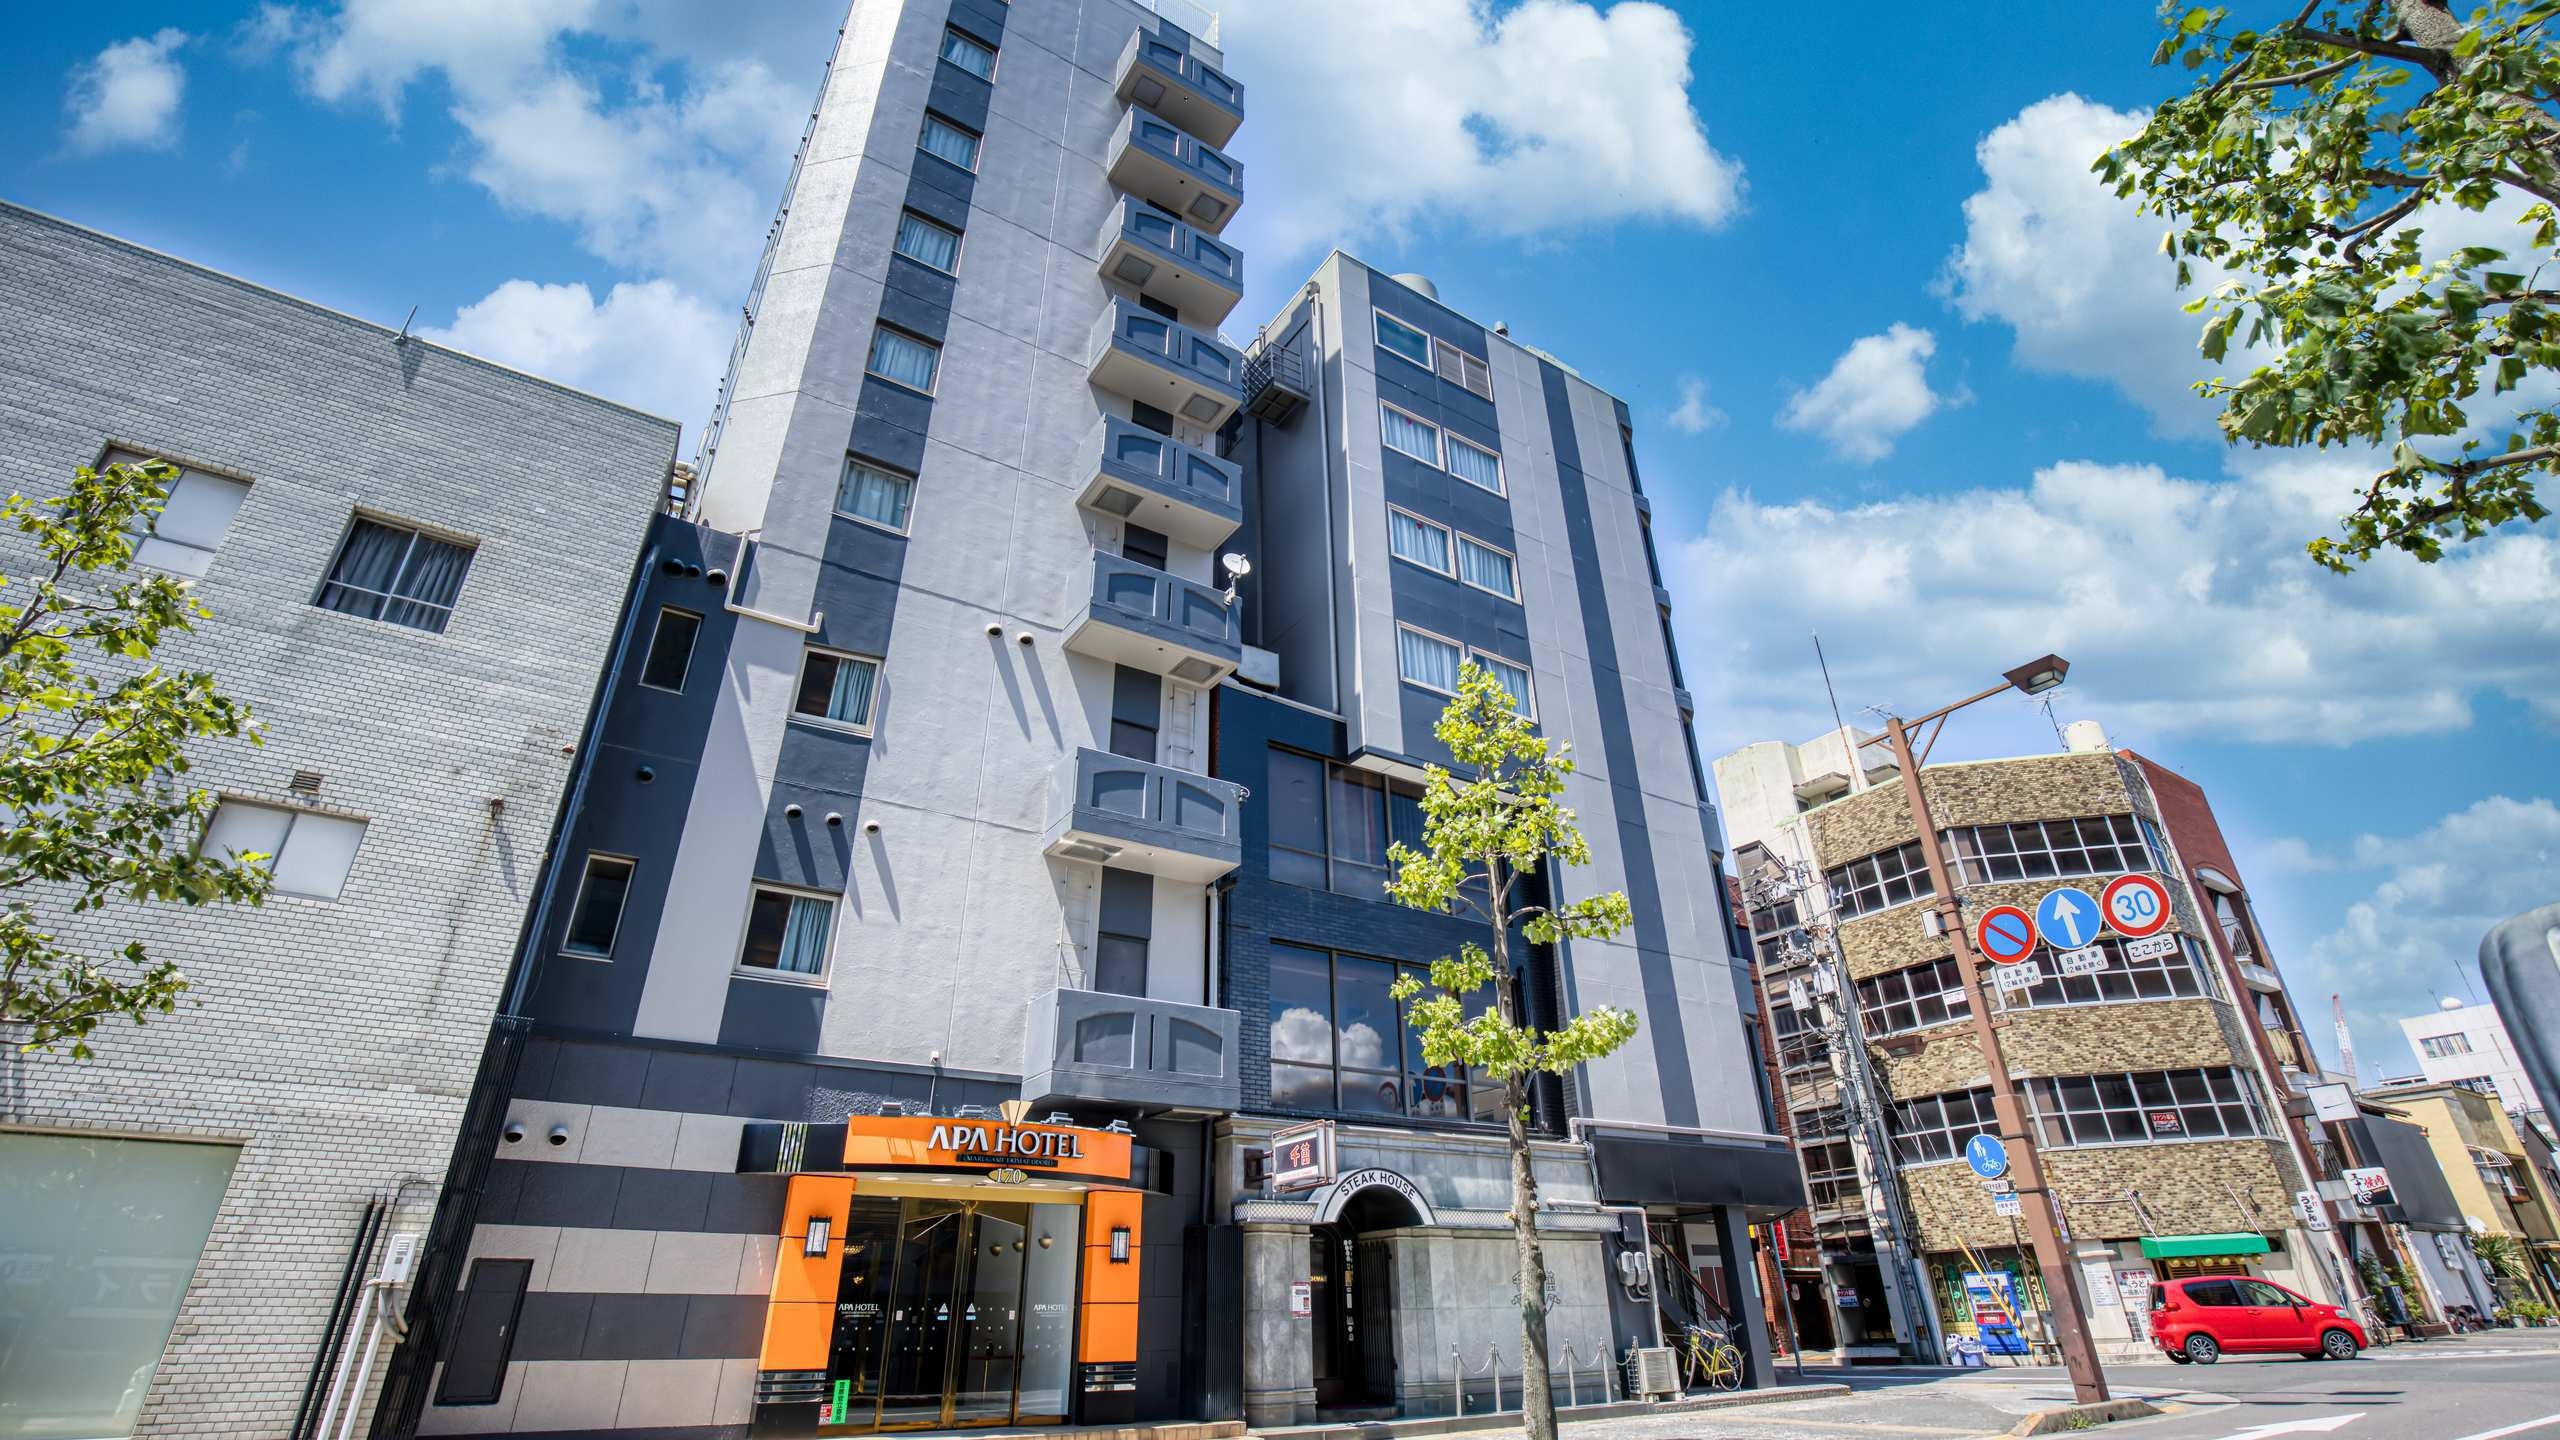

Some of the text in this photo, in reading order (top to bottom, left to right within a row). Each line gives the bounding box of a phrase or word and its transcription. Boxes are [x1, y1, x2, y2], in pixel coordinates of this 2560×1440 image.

[2117, 890, 2155, 921] 30
[2131, 938, 2174, 958] ここから
[2066, 950, 2098, 965] 自動車
[2003, 966, 2033, 979] 自動車
[927, 1125, 1085, 1159] APA HOTEL
[996, 1168, 1022, 1184] 170
[1340, 1172, 1377, 1197] STEAK
[1380, 1172, 1416, 1200] HOUSE
[838, 1303, 881, 1311] APA HOTEL
[1033, 1303, 1047, 1312] APA
